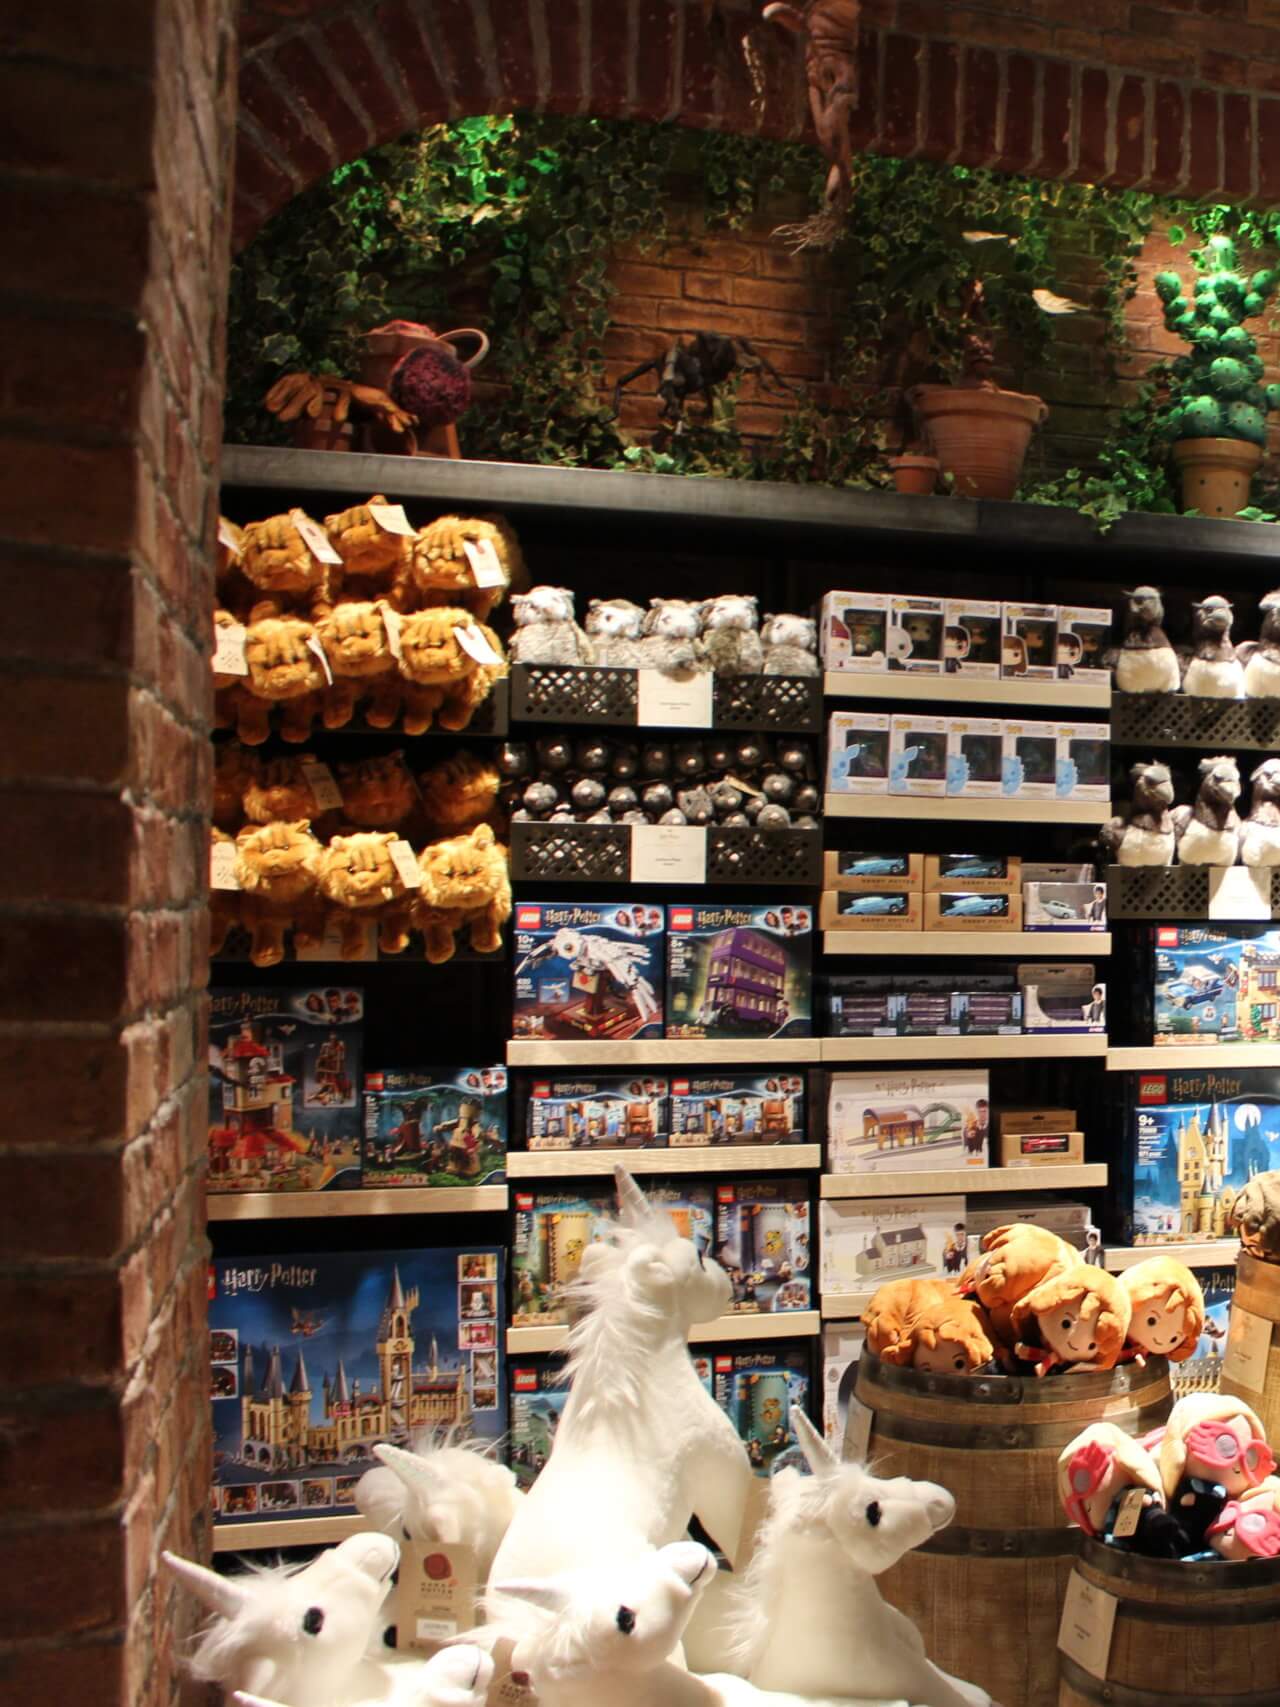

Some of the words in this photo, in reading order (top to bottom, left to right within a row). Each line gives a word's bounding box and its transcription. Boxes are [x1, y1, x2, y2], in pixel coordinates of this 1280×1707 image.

[1172, 1077, 1208, 1101] Harry
[1207, 1073, 1242, 1095] Potter
[1138, 1114, 1155, 1126] 9+
[222, 1267, 269, 1296] Harry
[269, 1263, 317, 1289] Potter
